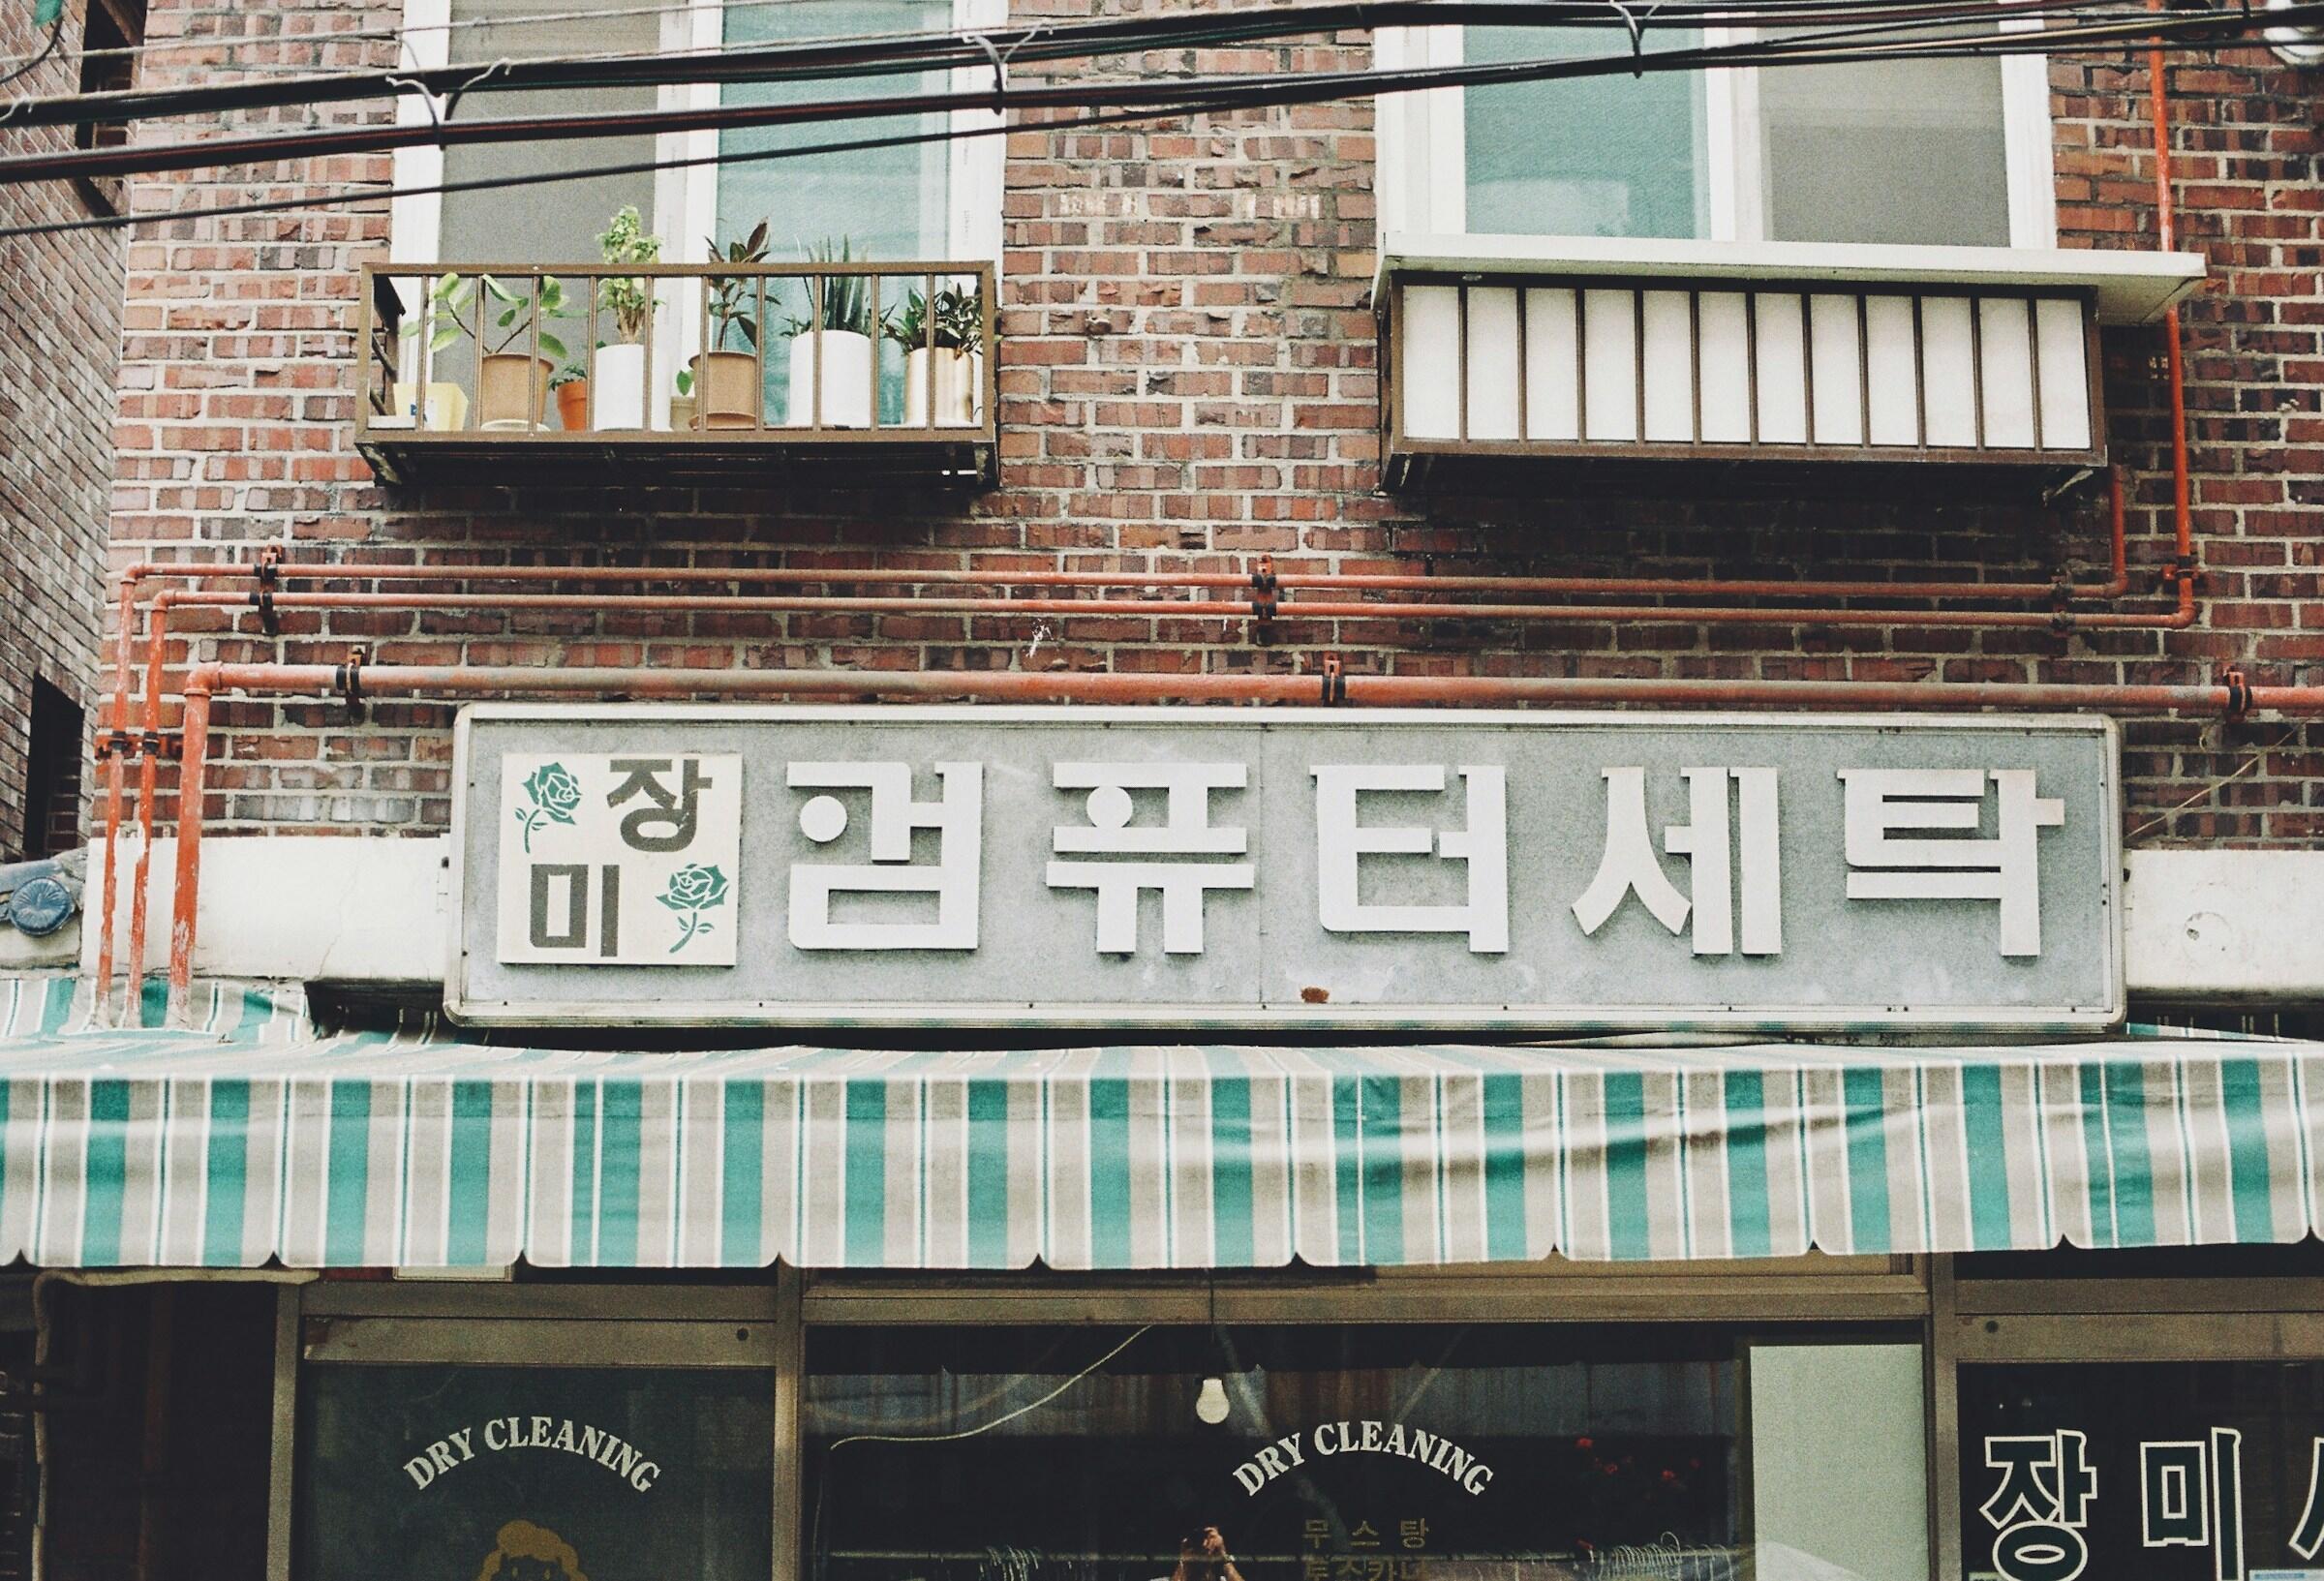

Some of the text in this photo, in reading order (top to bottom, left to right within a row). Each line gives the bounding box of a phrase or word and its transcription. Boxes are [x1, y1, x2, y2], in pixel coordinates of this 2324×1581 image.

[403, 1415, 661, 1492] DRY CLEANING
[1232, 1420, 1493, 1497] DRY CLEANING
[1979, 1427, 2324, 1581] 장미
